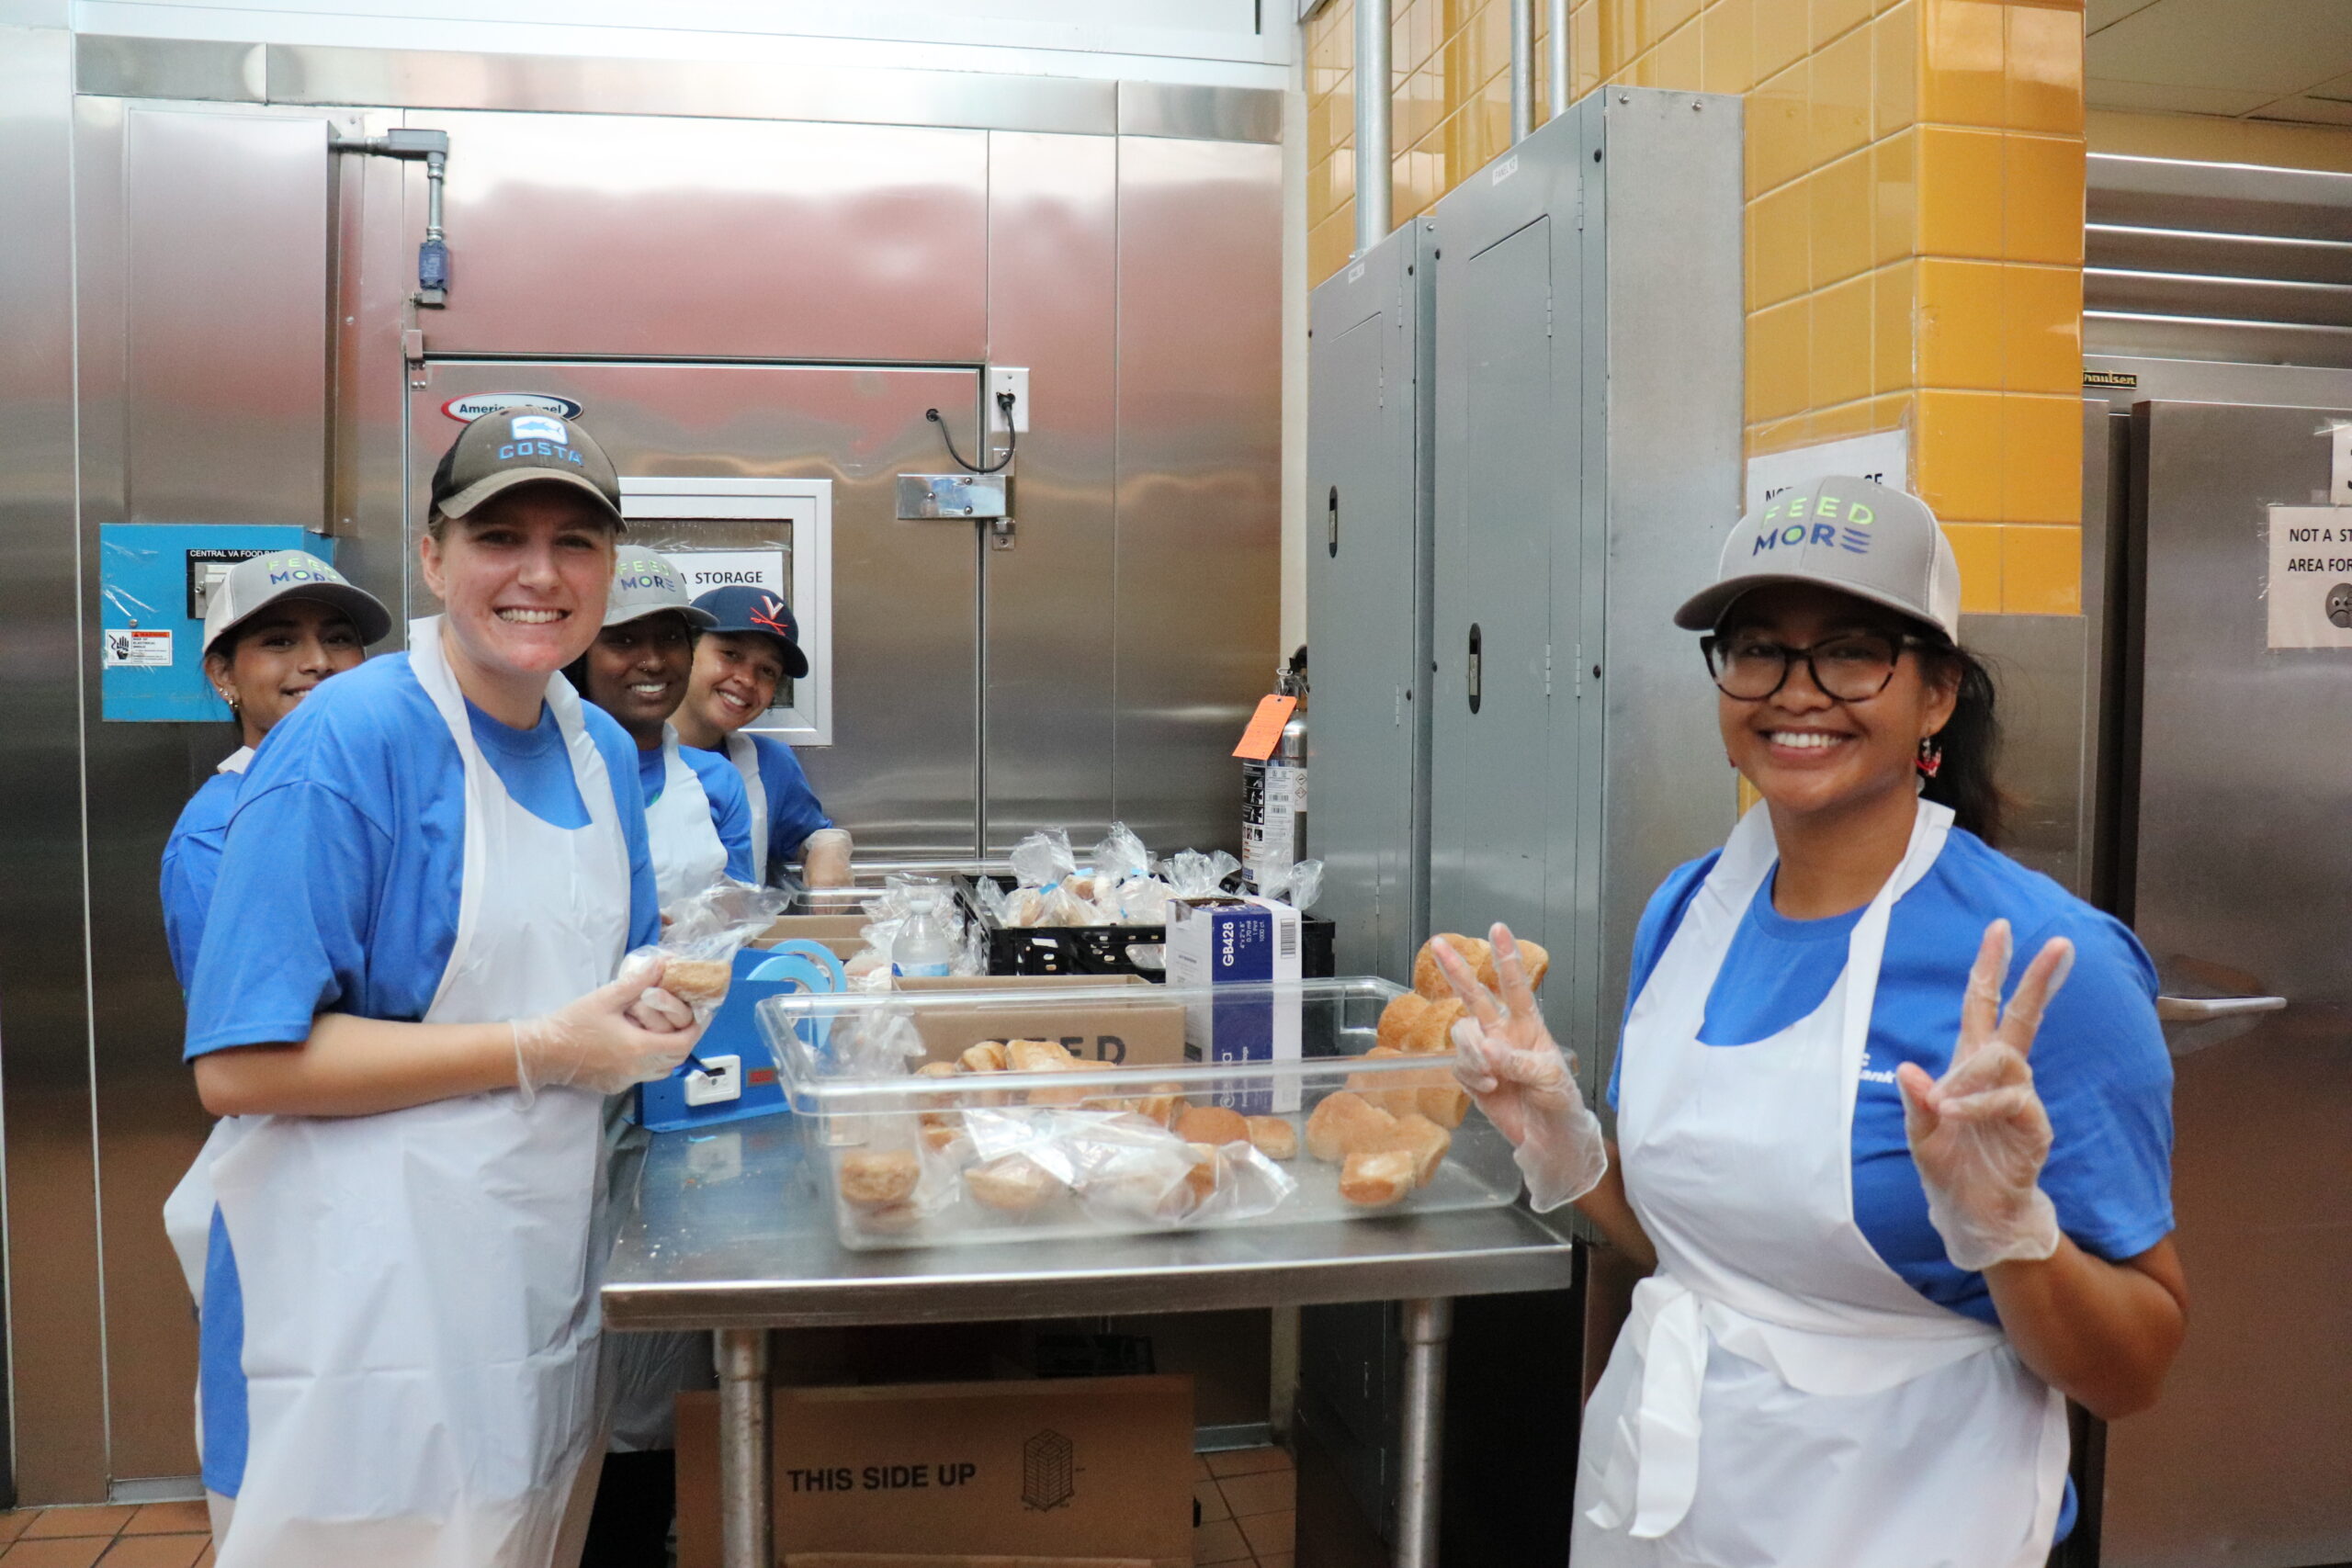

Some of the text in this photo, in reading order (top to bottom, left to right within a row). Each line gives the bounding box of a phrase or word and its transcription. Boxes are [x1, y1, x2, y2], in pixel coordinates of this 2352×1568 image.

[498, 442, 584, 467] COSTA
[1760, 495, 1876, 528] FEED
[1752, 523, 1871, 557] MORE
[2290, 528, 2320, 542] NOT
[2323, 528, 2333, 542] A
[189, 549, 227, 558] CENTRAL
[2288, 558, 2324, 571] AREA
[695, 570, 763, 584] STORAGE
[1222, 921, 1234, 966] GB428
[786, 1461, 977, 1493] THIS SIDE UP
